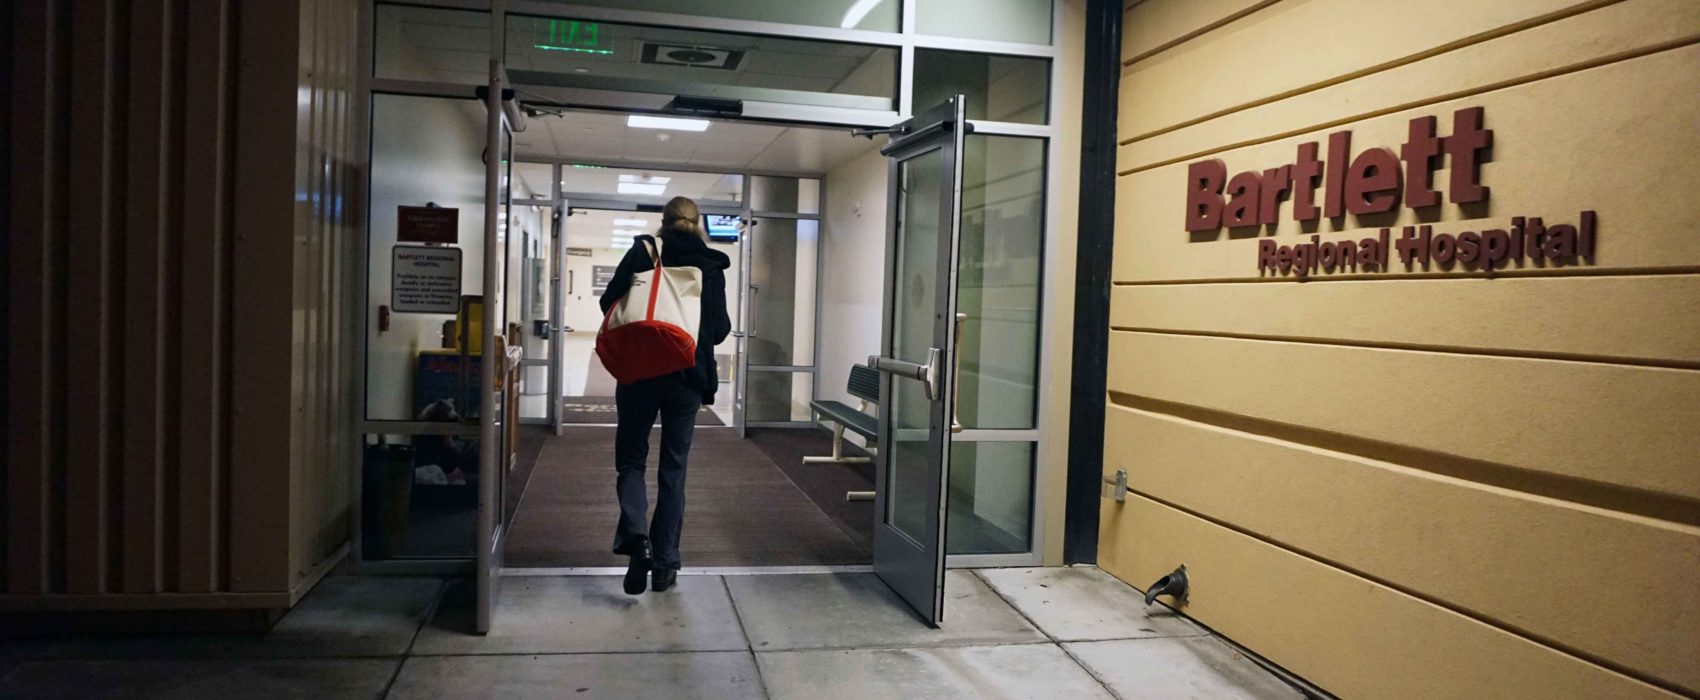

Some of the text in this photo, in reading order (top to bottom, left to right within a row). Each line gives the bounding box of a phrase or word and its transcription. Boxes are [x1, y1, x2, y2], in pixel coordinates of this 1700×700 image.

[1185, 106, 1494, 233] Bartlett
[1258, 210, 1597, 276] Regional Hospital
